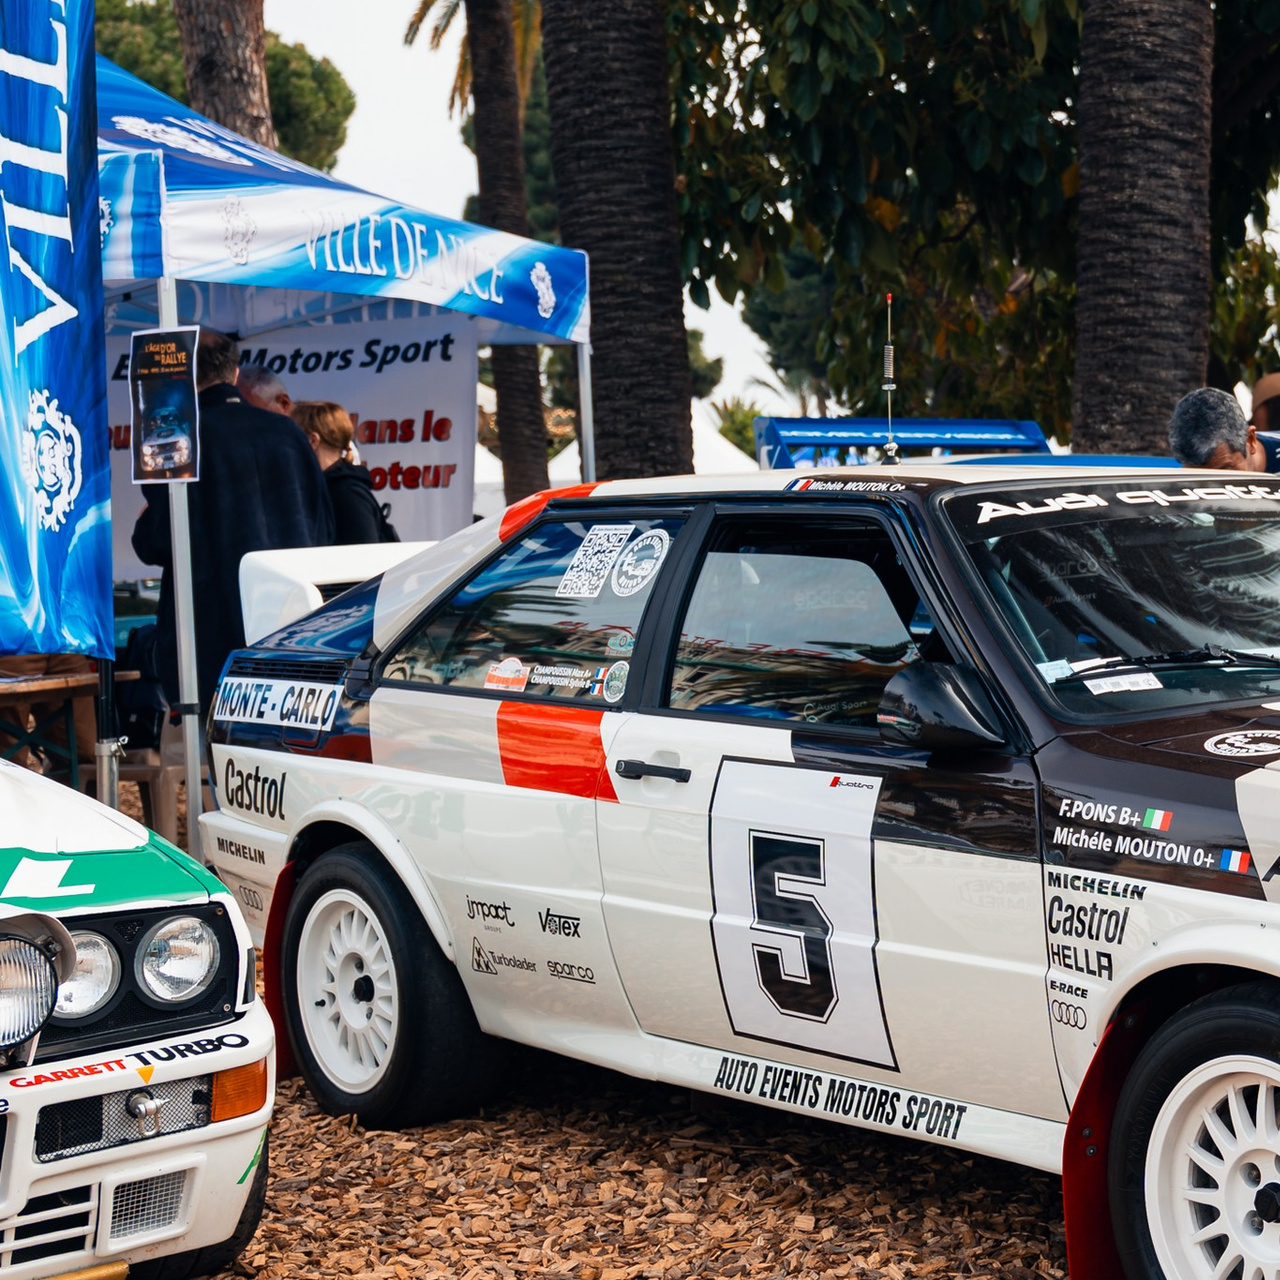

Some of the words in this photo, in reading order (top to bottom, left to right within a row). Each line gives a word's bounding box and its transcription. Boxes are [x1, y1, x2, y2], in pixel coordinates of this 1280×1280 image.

[301, 210, 388, 277] VILLE
[388, 216, 433, 286] DE
[435, 229, 504, 304] NICE
[161, 352, 187, 366] RALLYE
[359, 333, 455, 374] Sport
[421, 409, 452, 443] le
[365, 461, 457, 491] oteur
[977, 492, 1109, 524] Audi
[216, 681, 273, 719] MONTE
[279, 685, 337, 726] CARLO
[225, 757, 287, 821] Castrol
[1058, 799, 1118, 823] F.PONS
[1118, 807, 1142, 827] B+
[216, 836, 266, 866] MICHELIN
[1114, 836, 1191, 864] MOUTON
[1047, 871, 1148, 901] MICHELIN
[748, 829, 839, 1023] 5
[1048, 895, 1130, 945] Castrol
[488, 950, 537, 973] Turbolader
[547, 960, 594, 980] sparco
[1050, 942, 1113, 981] HELLA
[1050, 980, 1089, 999] E-RACE
[125, 1033, 250, 1066] TURBO
[9, 1059, 124, 1088] GARRETT
[713, 1056, 759, 1095] AUTO
[758, 1066, 823, 1109] EVENTS
[823, 1078, 901, 1127] MOTORS
[902, 1095, 968, 1140] SPORT
